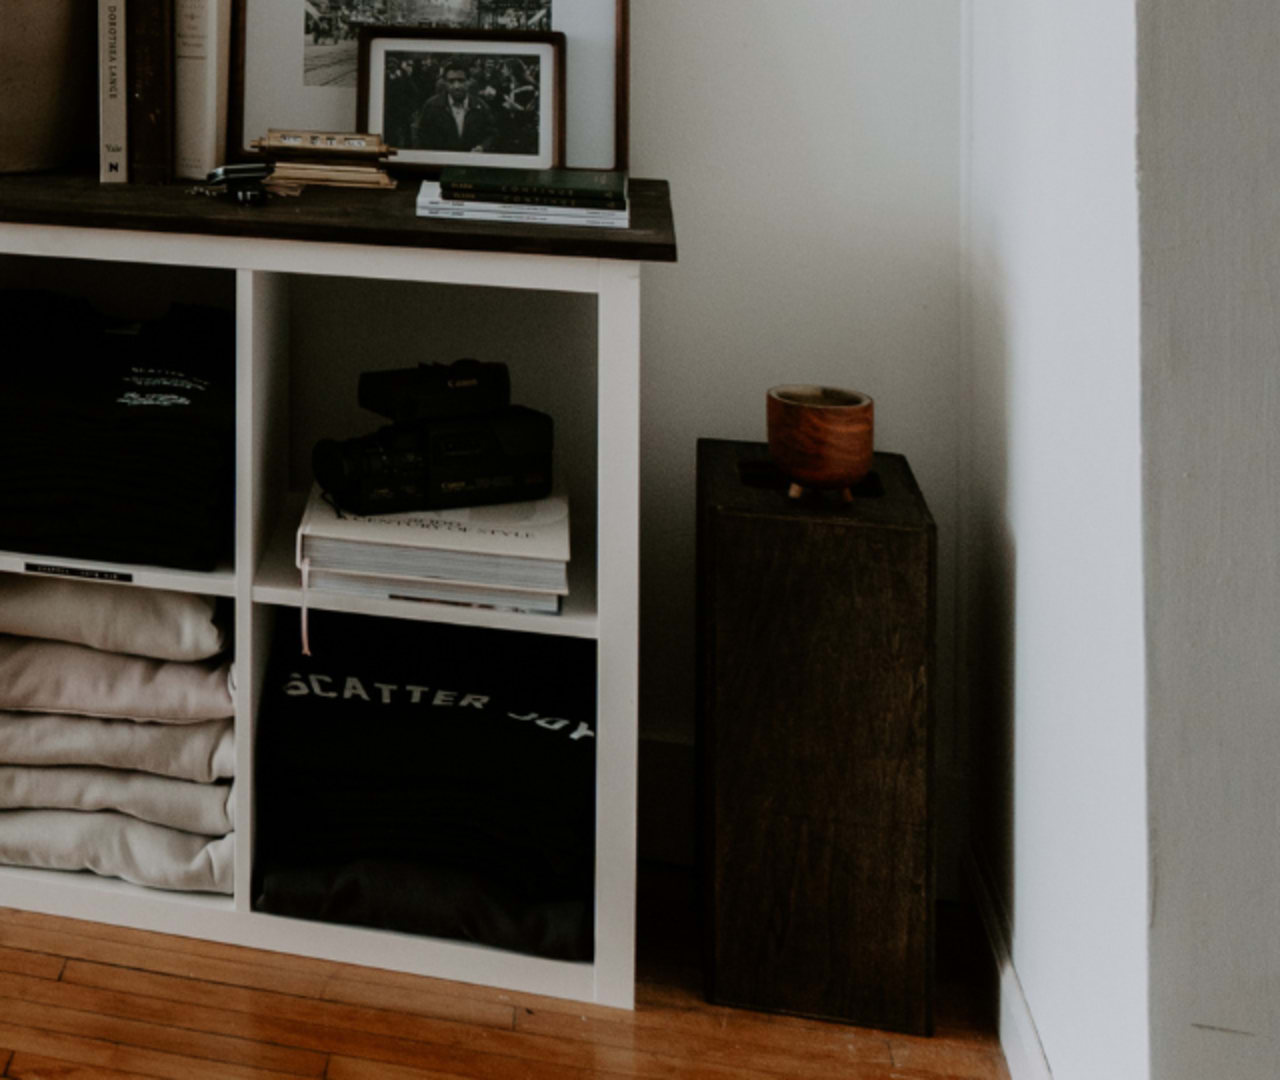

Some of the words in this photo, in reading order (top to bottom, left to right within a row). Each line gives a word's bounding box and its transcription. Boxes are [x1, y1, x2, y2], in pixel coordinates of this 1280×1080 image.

[107, 5, 118, 63] DOROTHEA
[108, 65, 118, 99] LANGE
[284, 672, 490, 709] SCATTER
[507, 711, 595, 741] JOY
